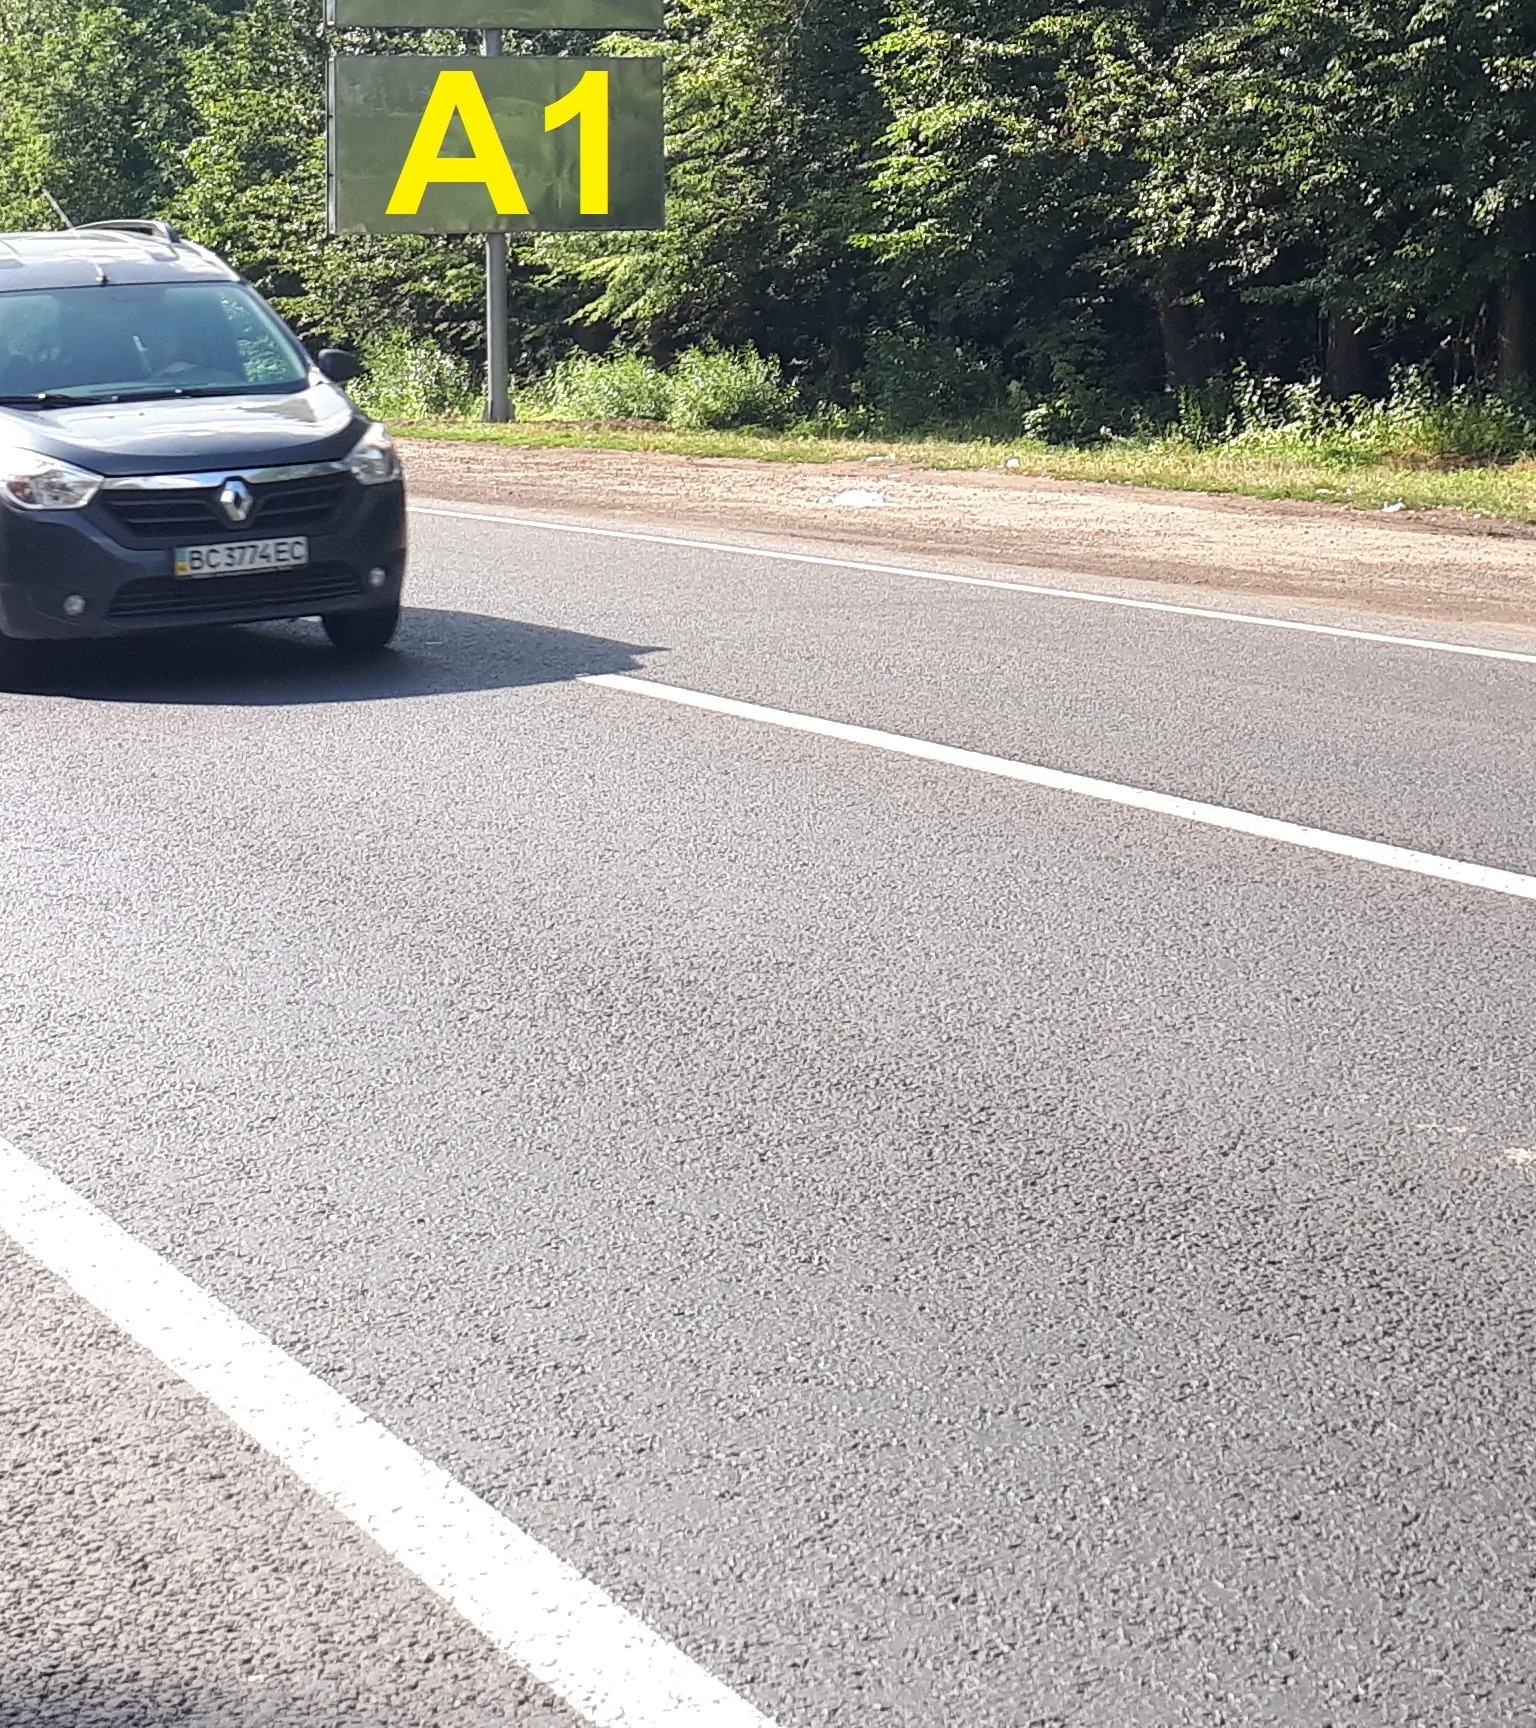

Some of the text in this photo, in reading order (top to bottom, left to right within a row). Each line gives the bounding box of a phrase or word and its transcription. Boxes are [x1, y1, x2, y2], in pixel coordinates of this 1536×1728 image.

[190, 541, 304, 570] BC 3774 EC
